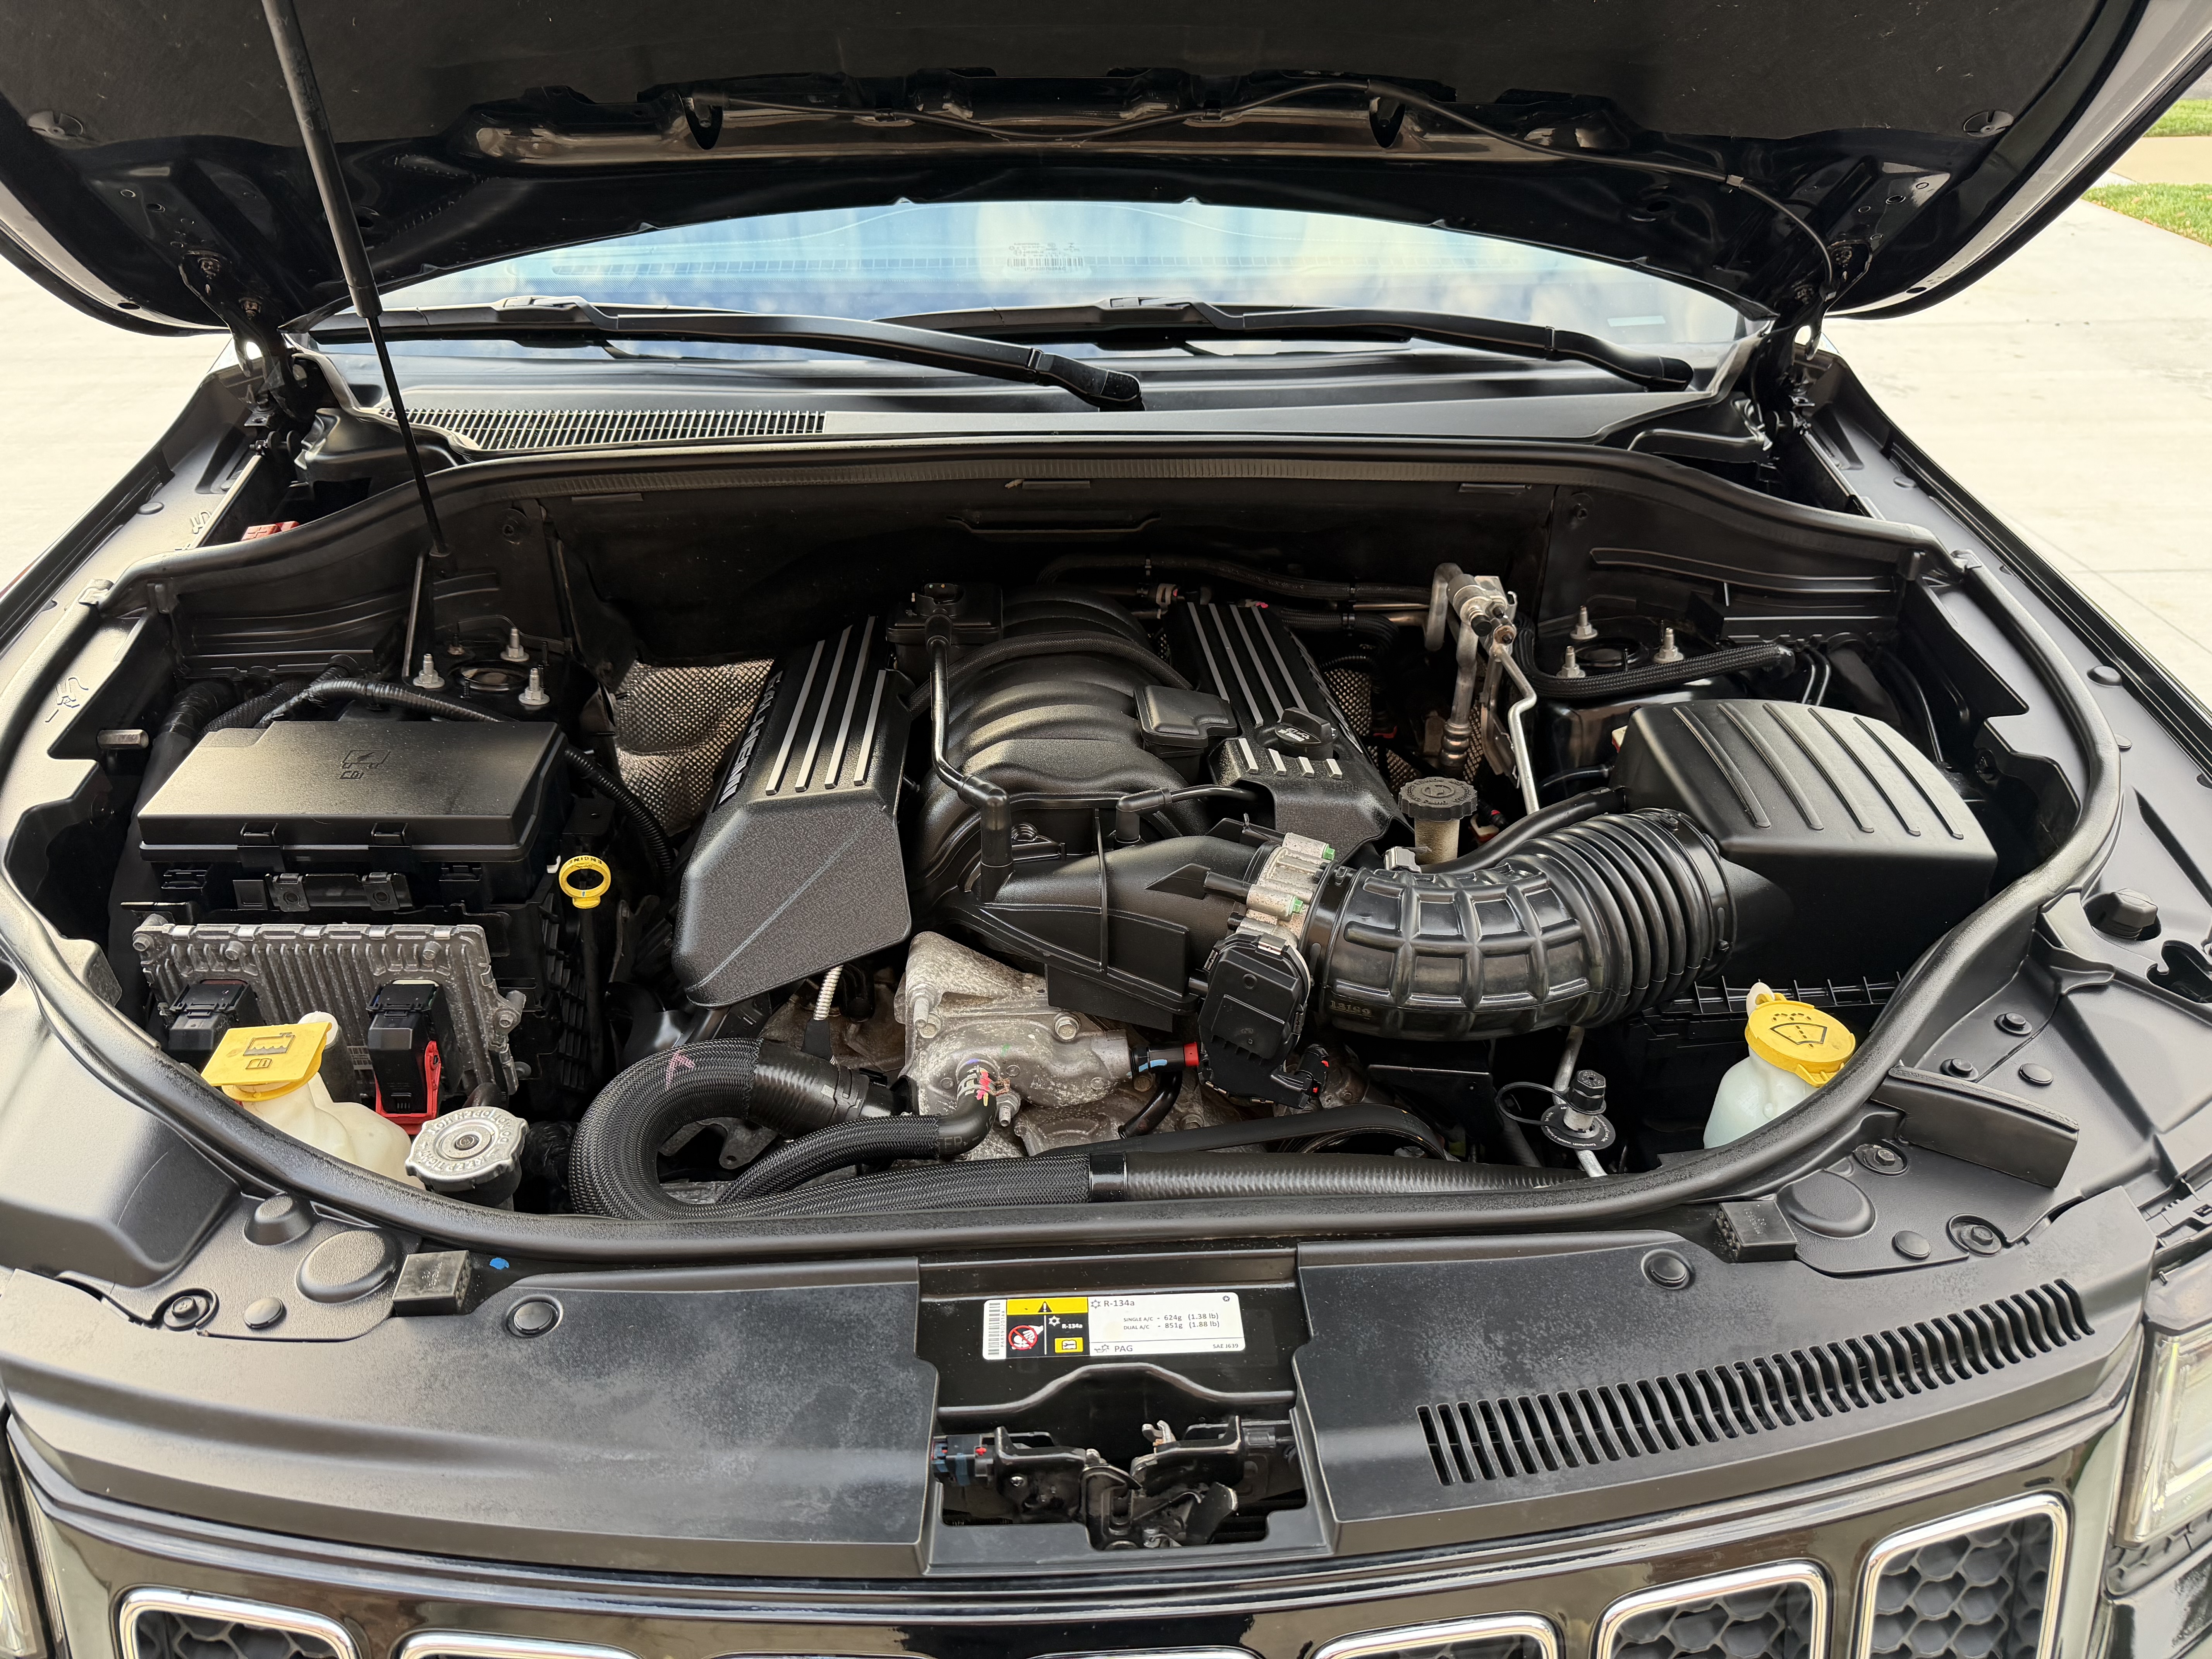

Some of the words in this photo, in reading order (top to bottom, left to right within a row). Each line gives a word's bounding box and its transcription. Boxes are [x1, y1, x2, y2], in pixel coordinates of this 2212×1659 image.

[719, 715, 766, 805] HEMI
[568, 856, 603, 866] ENGINE
[454, 1109, 490, 1121] OPEN
[428, 1116, 453, 1135] HOT
[418, 1150, 446, 1171] TIGHT
[445, 1156, 485, 1172] KEEP
